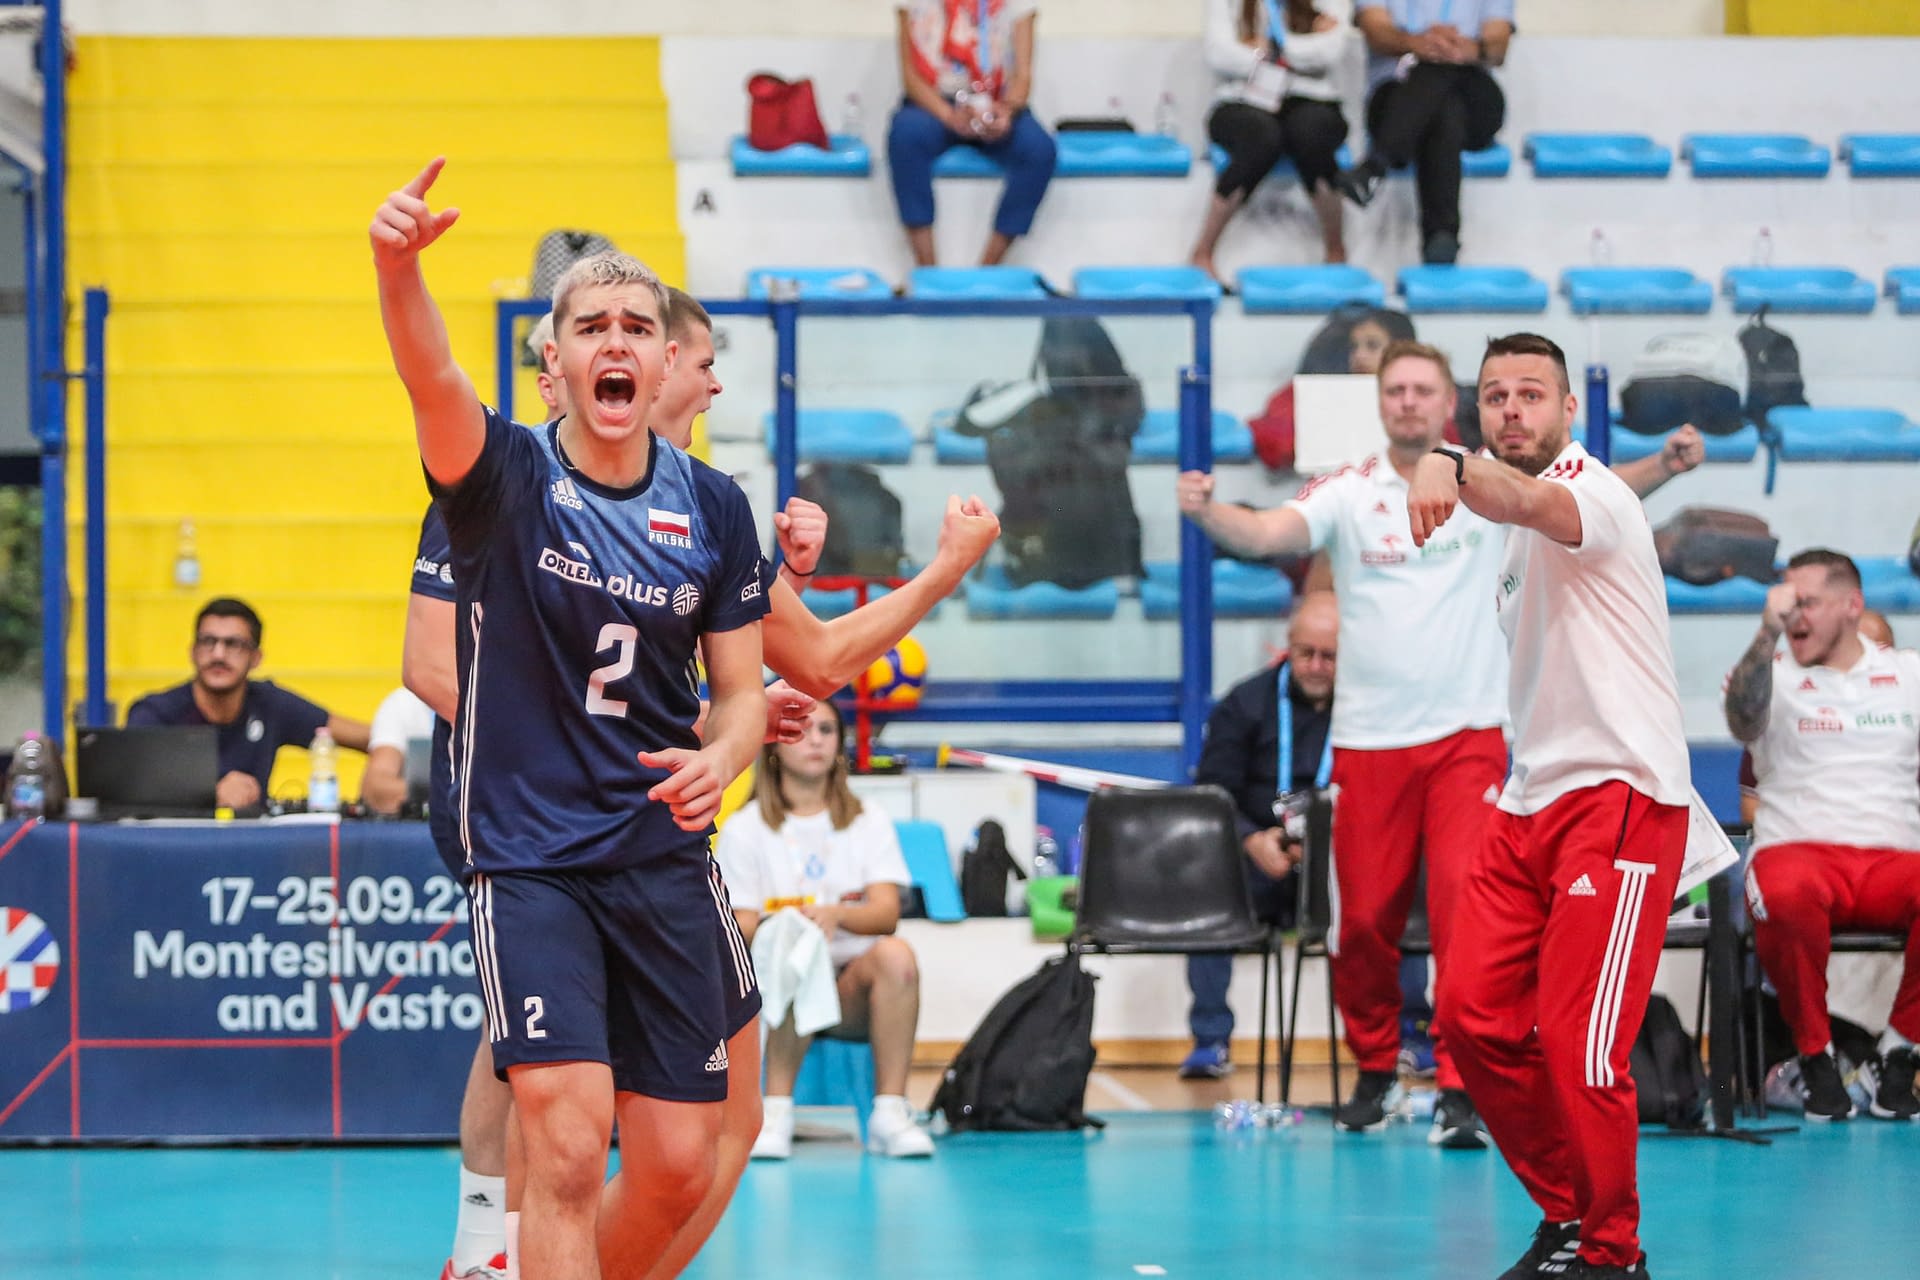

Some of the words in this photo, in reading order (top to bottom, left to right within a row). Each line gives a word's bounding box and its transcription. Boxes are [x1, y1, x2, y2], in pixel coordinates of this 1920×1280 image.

[694, 188, 716, 213] A
[648, 531, 692, 549] POLSKA
[606, 574, 668, 607] plus
[585, 622, 638, 718] 2
[217, 980, 317, 1031] and
[329, 983, 486, 1031] Vasto
[524, 996, 547, 1039] 2
